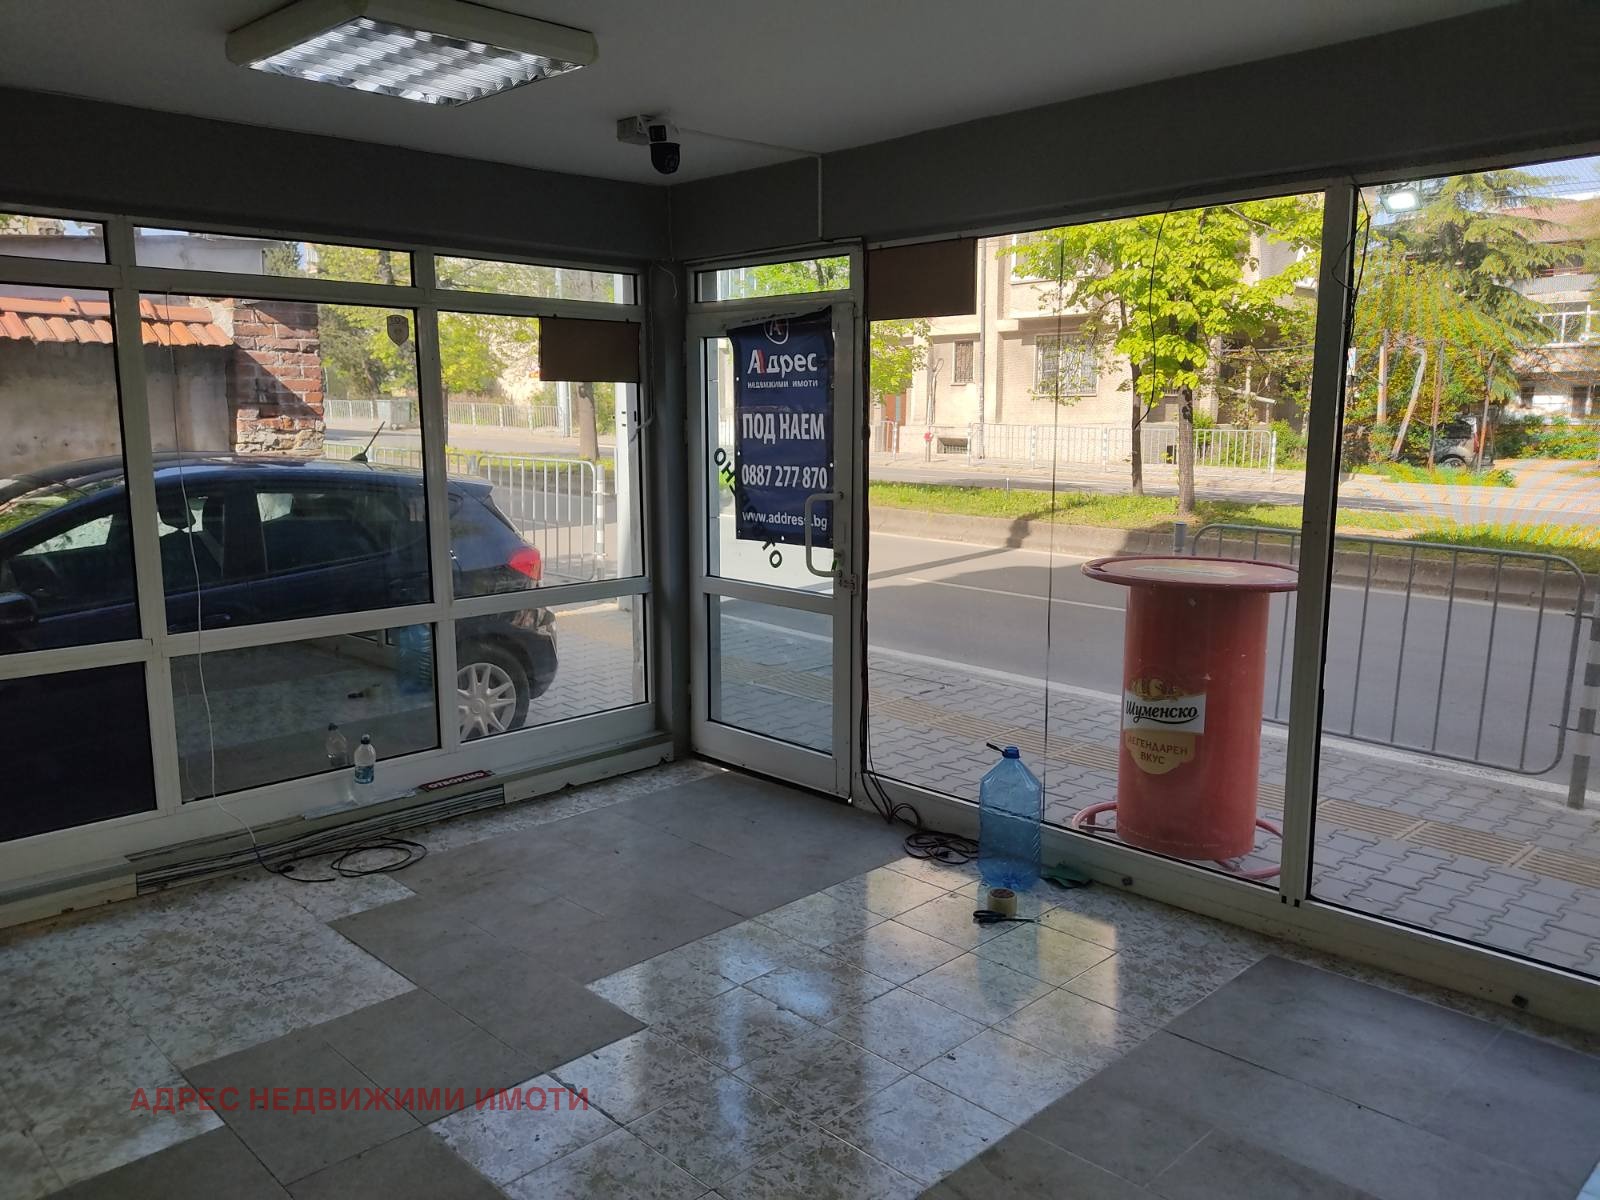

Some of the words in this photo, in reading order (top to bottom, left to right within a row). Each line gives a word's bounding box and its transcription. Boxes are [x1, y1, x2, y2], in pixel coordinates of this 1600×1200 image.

[747, 349, 818, 378] Адрес
[742, 413, 776, 445] ПОД
[779, 413, 825, 440] НАЕМ
[741, 464, 772, 486] 0887
[774, 466, 799, 488] 277
[802, 467, 828, 490] 870
[742, 511, 828, 531] www.addres.bg
[1126, 700, 1199, 724] Шуменско
[1140, 751, 1166, 764] ВКУС
